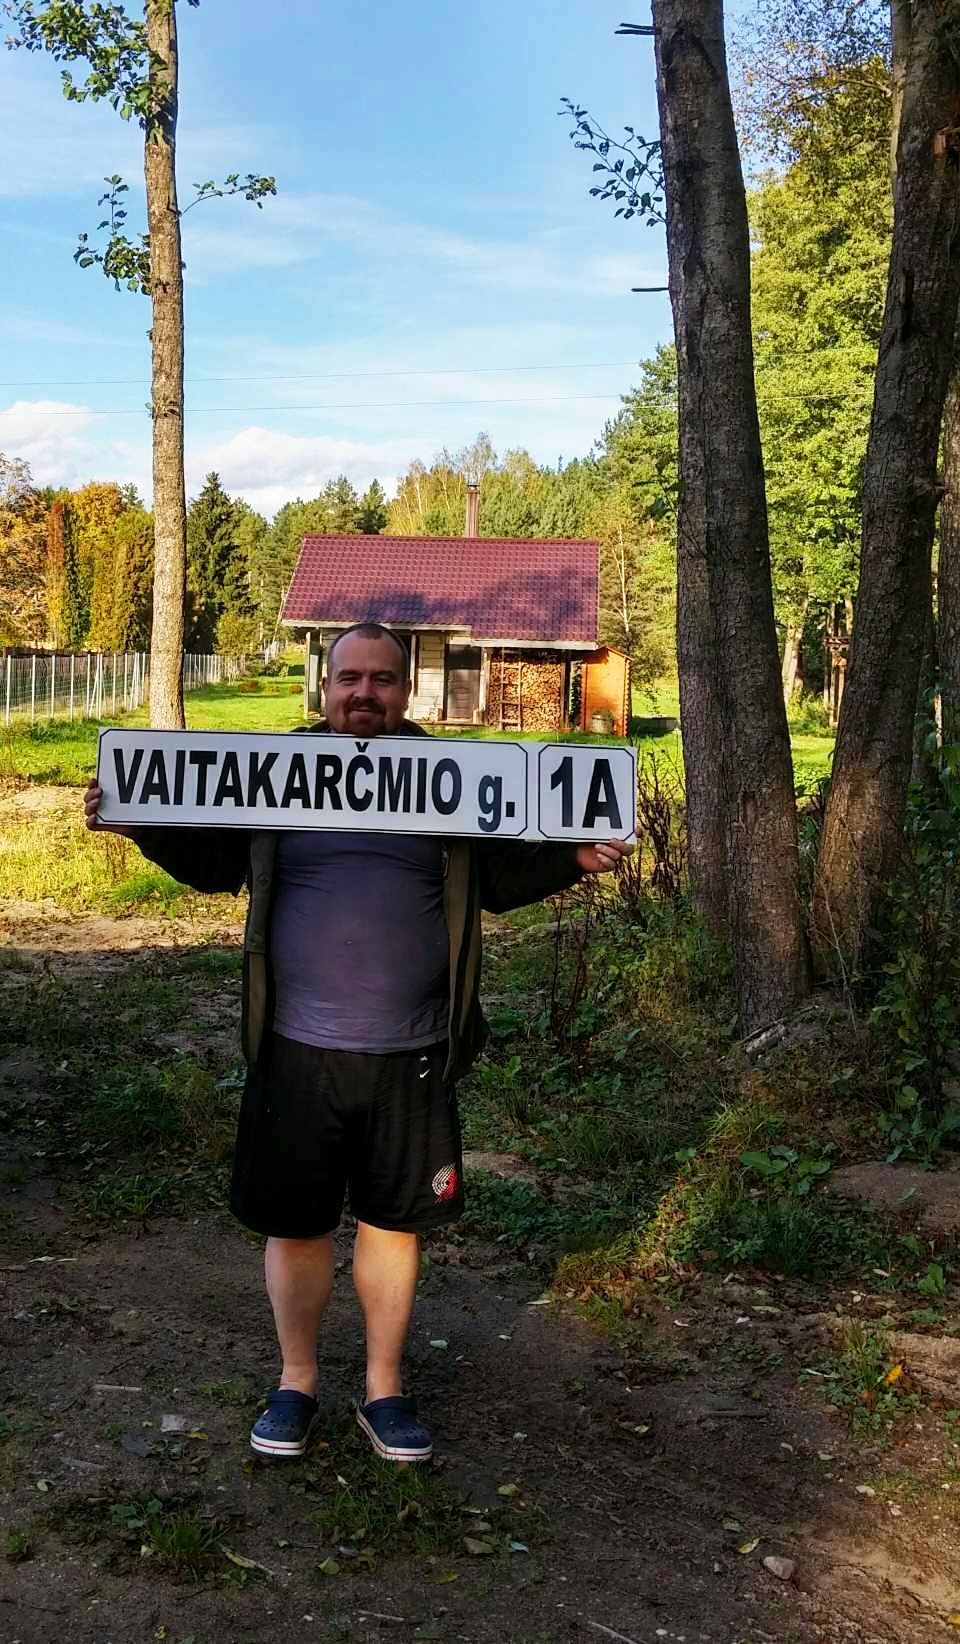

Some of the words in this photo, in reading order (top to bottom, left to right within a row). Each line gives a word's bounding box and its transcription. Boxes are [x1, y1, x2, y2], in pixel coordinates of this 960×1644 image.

[113, 742, 462, 815] VAITAKARČMIO
[478, 775, 516, 832] g.
[550, 756, 622, 829] 1A
